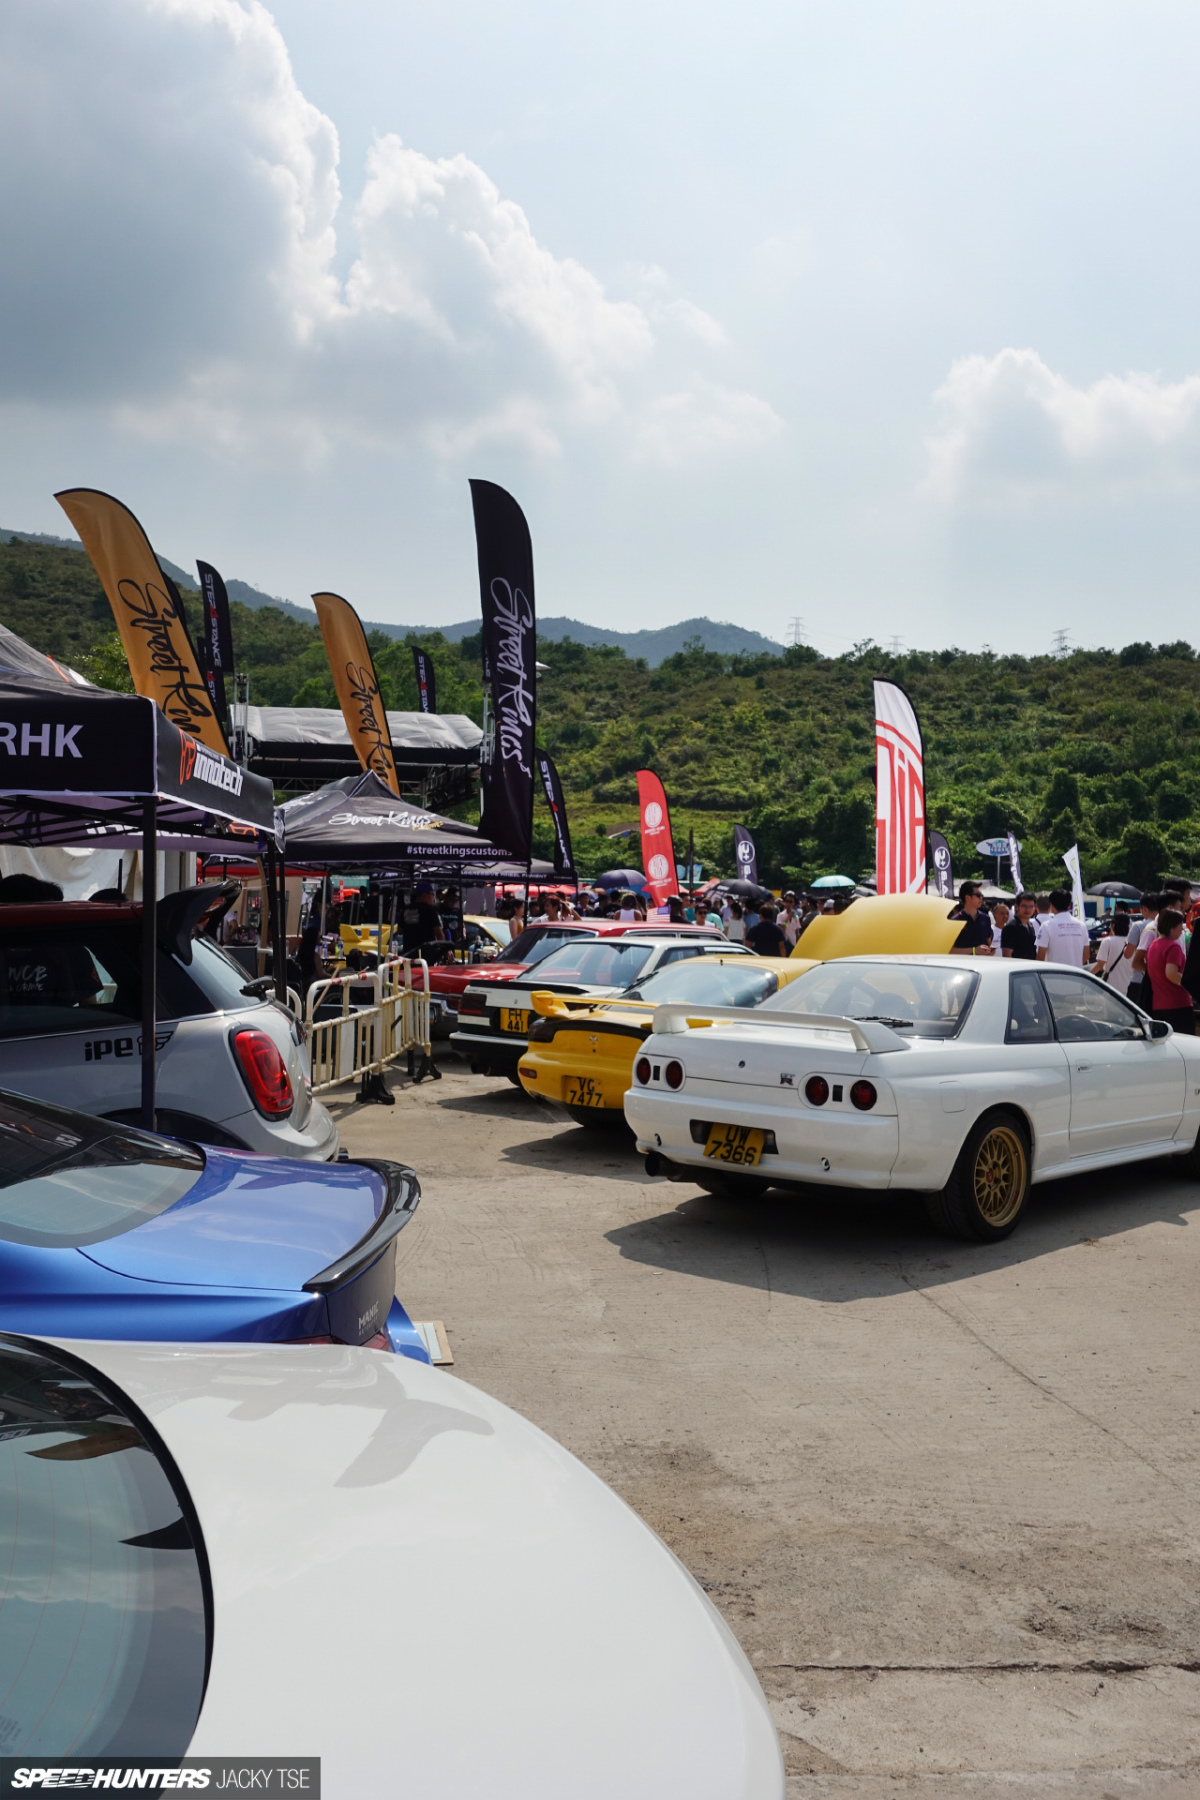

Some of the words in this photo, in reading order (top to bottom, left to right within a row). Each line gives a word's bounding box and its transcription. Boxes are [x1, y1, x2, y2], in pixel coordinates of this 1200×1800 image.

[117, 578, 190, 676] Street
[490, 576, 534, 681] Street
[193, 756, 243, 796] innotech
[328, 812, 383, 827] Street
[386, 810, 436, 828] Kings
[406, 844, 513, 857] #streetkingscustoms
[507, 1021, 524, 1032] 441
[578, 1077, 596, 1092] VG
[569, 1089, 603, 1107] 7477
[725, 1125, 752, 1146] UW
[707, 1140, 757, 1165] 7366
